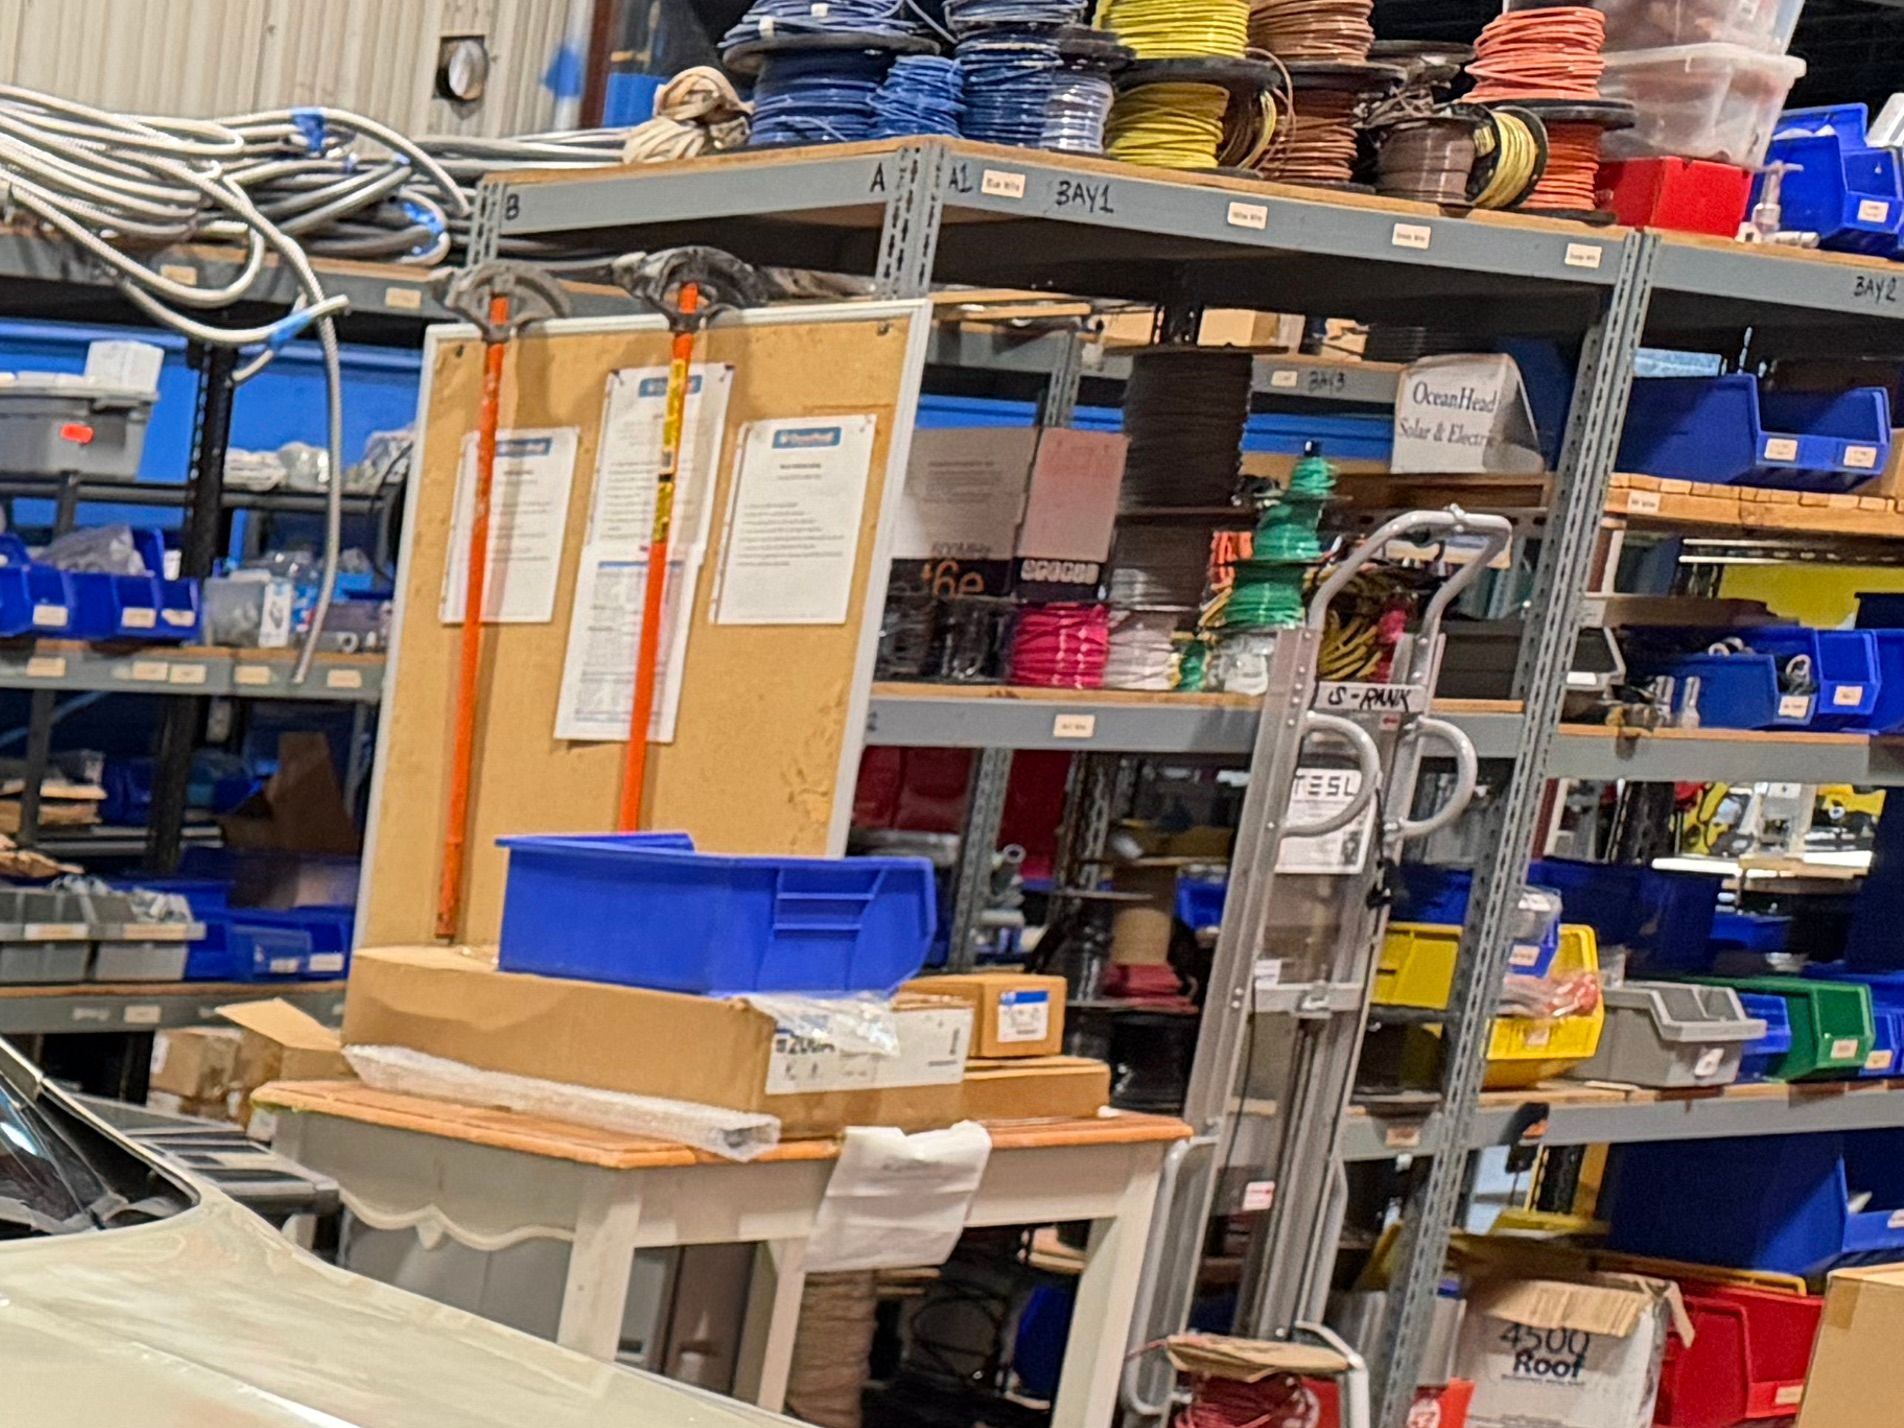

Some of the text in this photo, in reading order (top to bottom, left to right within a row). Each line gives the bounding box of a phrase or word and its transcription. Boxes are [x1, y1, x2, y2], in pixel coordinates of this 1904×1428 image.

[869, 161, 886, 193] A
[947, 163, 974, 194] A1
[504, 193, 521, 221] B
[1054, 179, 1115, 214] BAY1
[1853, 275, 1898, 302] BAY2
[1412, 379, 1499, 414] OceanHead
[1399, 416, 1431, 440] Solar
[1293, 774, 1357, 797] TESL
[1512, 1348, 1586, 1379] Roof
